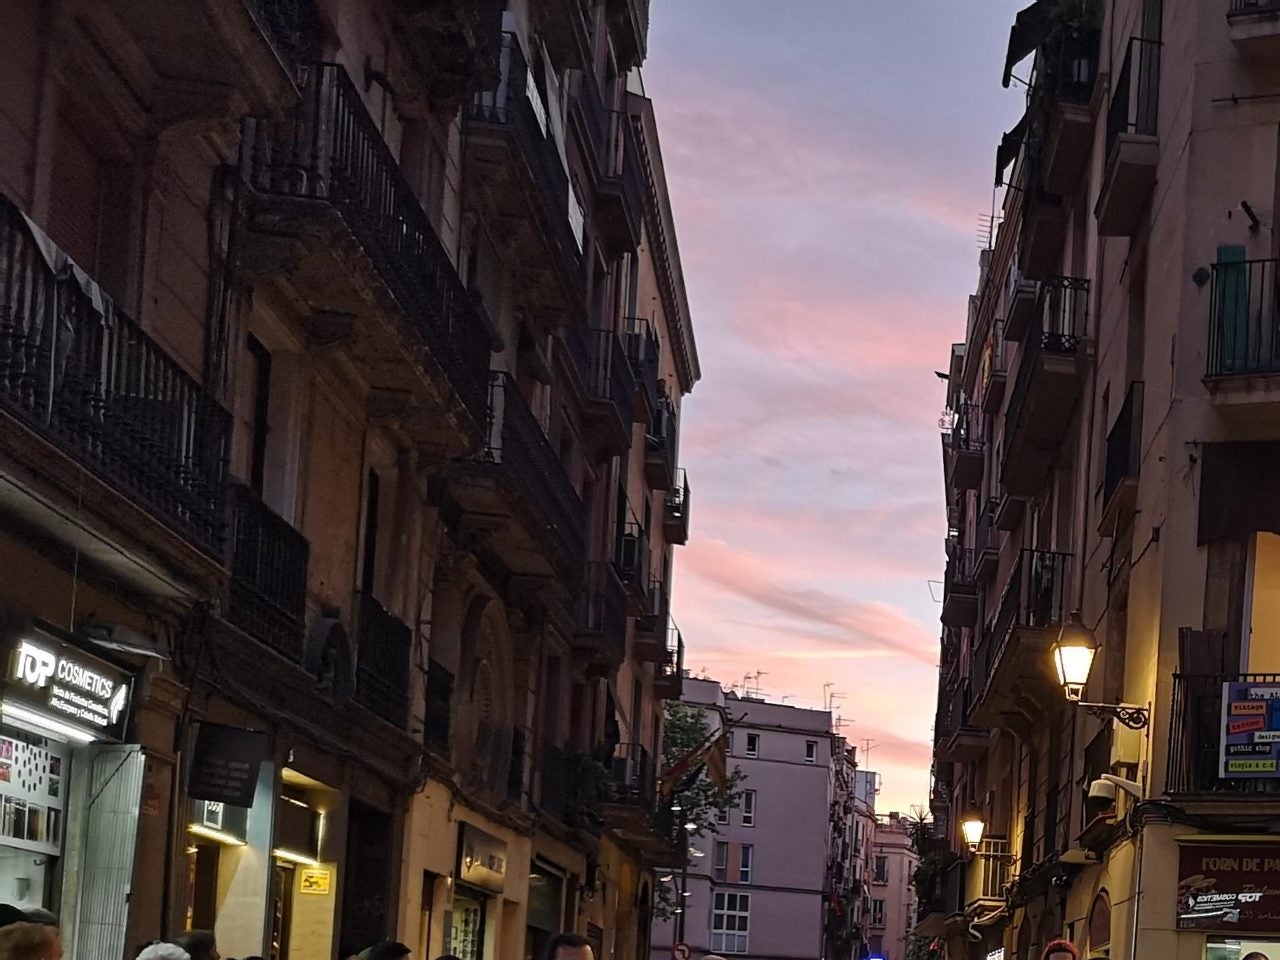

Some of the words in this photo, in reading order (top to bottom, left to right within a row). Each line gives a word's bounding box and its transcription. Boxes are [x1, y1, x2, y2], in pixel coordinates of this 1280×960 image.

[16, 639, 56, 688] TOP
[57, 659, 113, 699] COSMETICS
[1250, 692, 1264, 700] the
[1233, 704, 1264, 712] vintage
[1230, 744, 1253, 753] gothic
[1255, 744, 1271, 753] shop
[1201, 857, 1239, 872] FORN
[1242, 858, 1262, 872] DE
